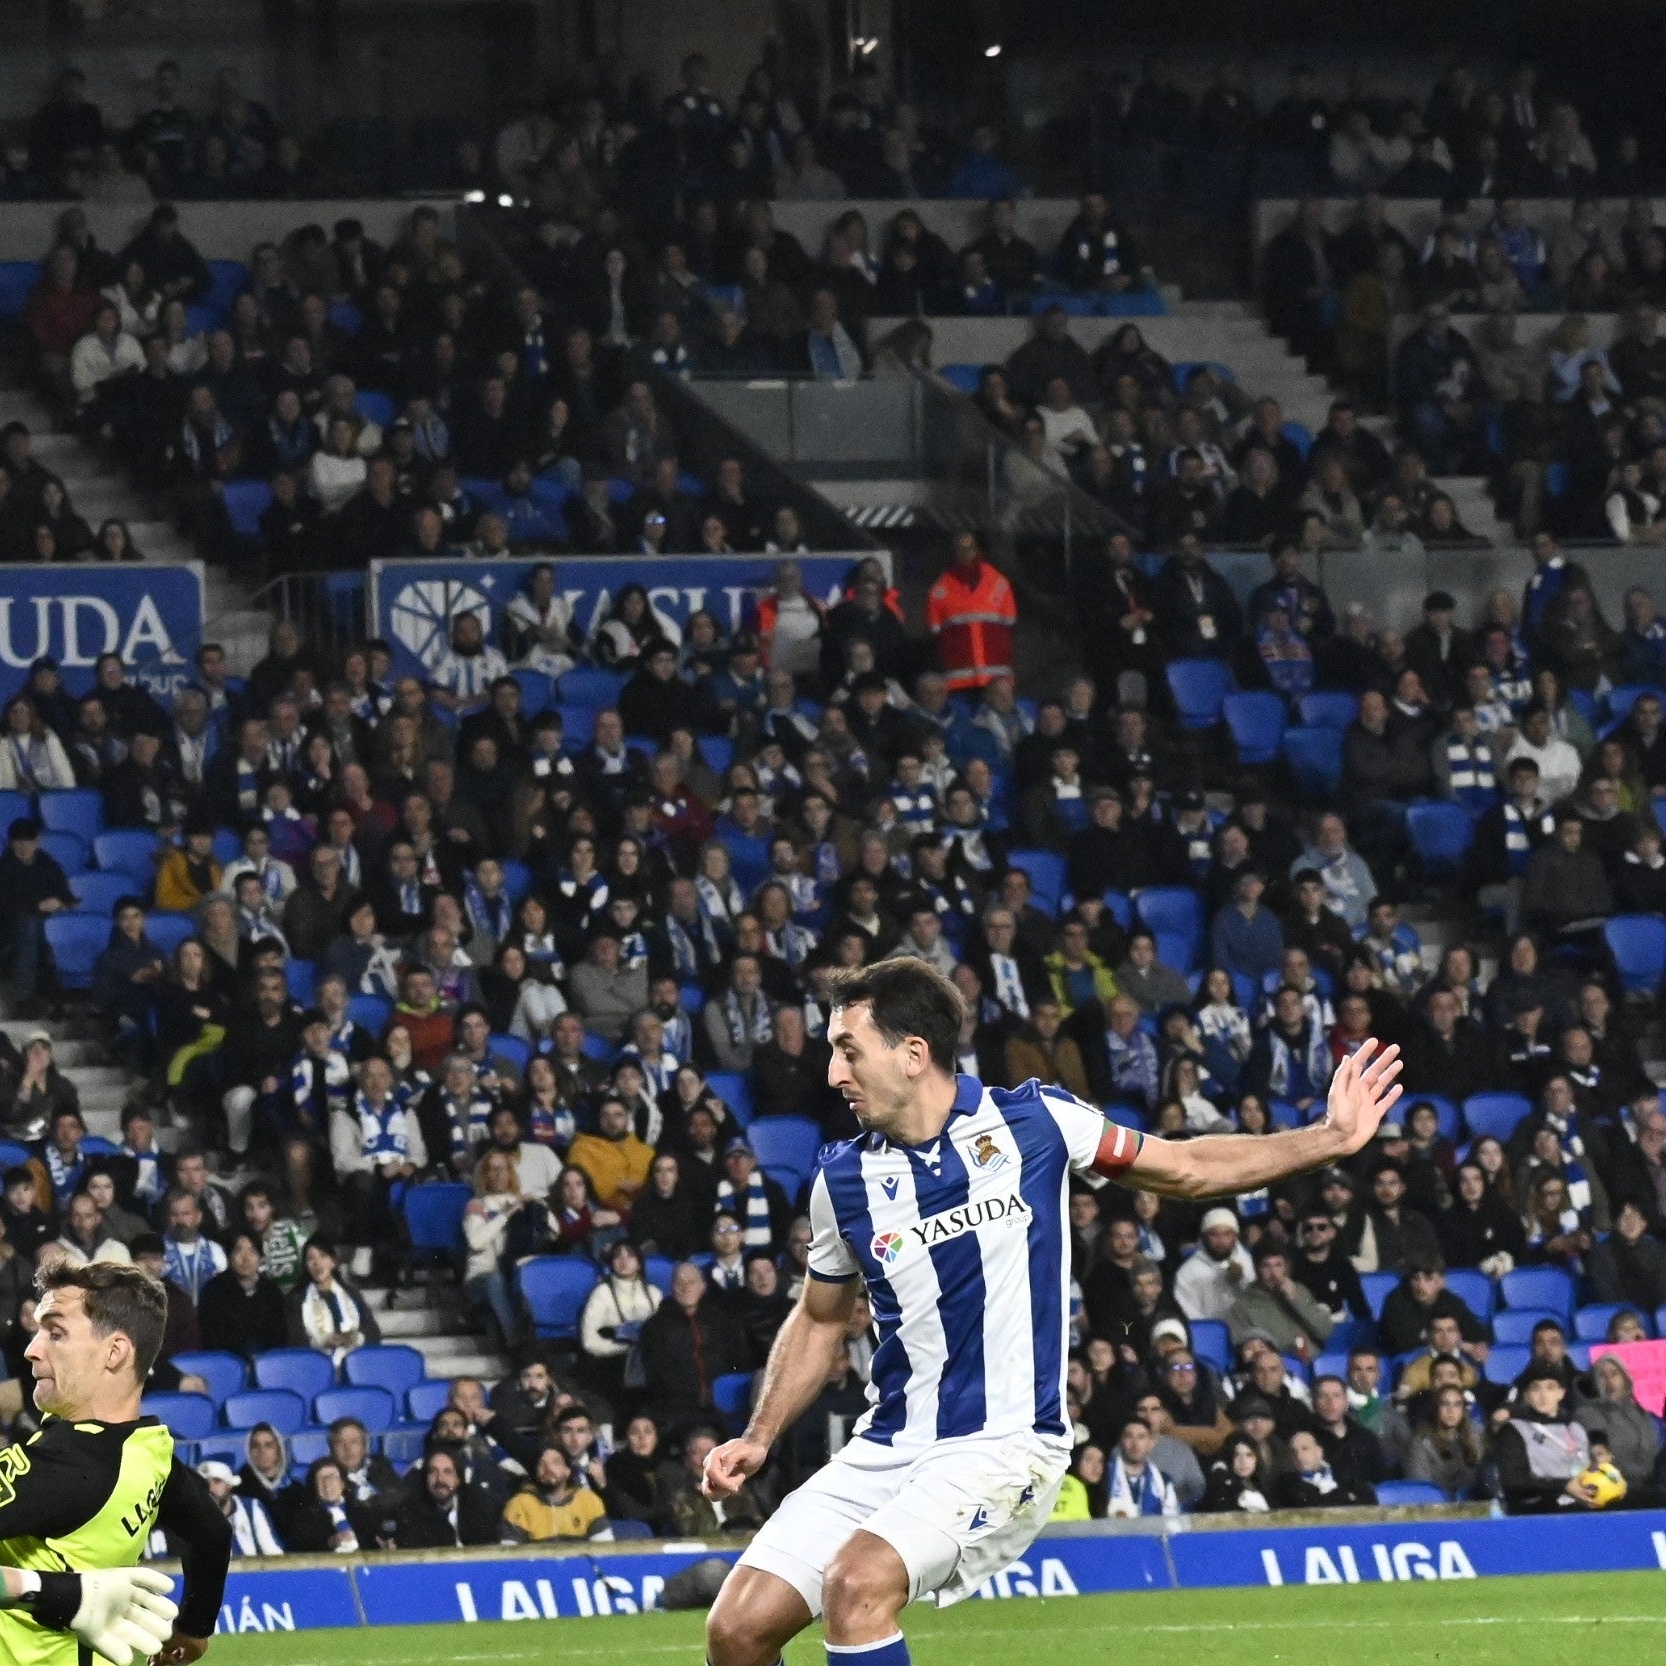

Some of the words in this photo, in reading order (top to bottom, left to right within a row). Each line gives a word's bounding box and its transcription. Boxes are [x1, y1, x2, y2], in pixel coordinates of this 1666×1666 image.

[909, 1194, 1028, 1246] YASUDA
[1005, 1214, 1029, 1229] group
[1261, 1540, 1478, 1586] LALIGA
